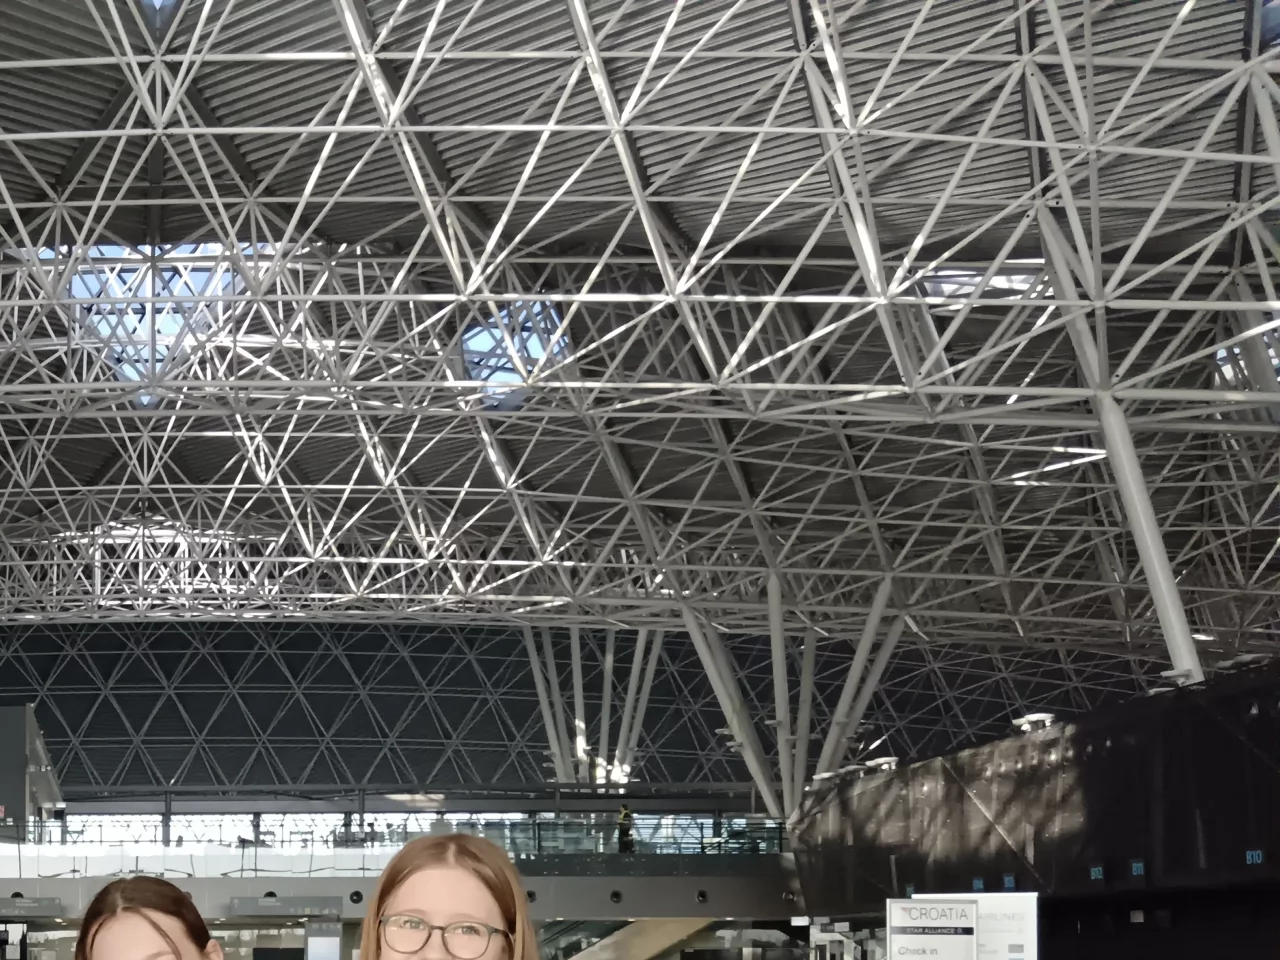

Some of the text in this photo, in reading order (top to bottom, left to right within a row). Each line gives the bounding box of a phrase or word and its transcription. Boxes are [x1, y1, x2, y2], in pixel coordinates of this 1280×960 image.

[1245, 850, 1263, 865] B10
[909, 907, 969, 921] CROATIA
[906, 927, 955, 935] STAR ALLIANCE
[898, 946, 938, 956] Check in
